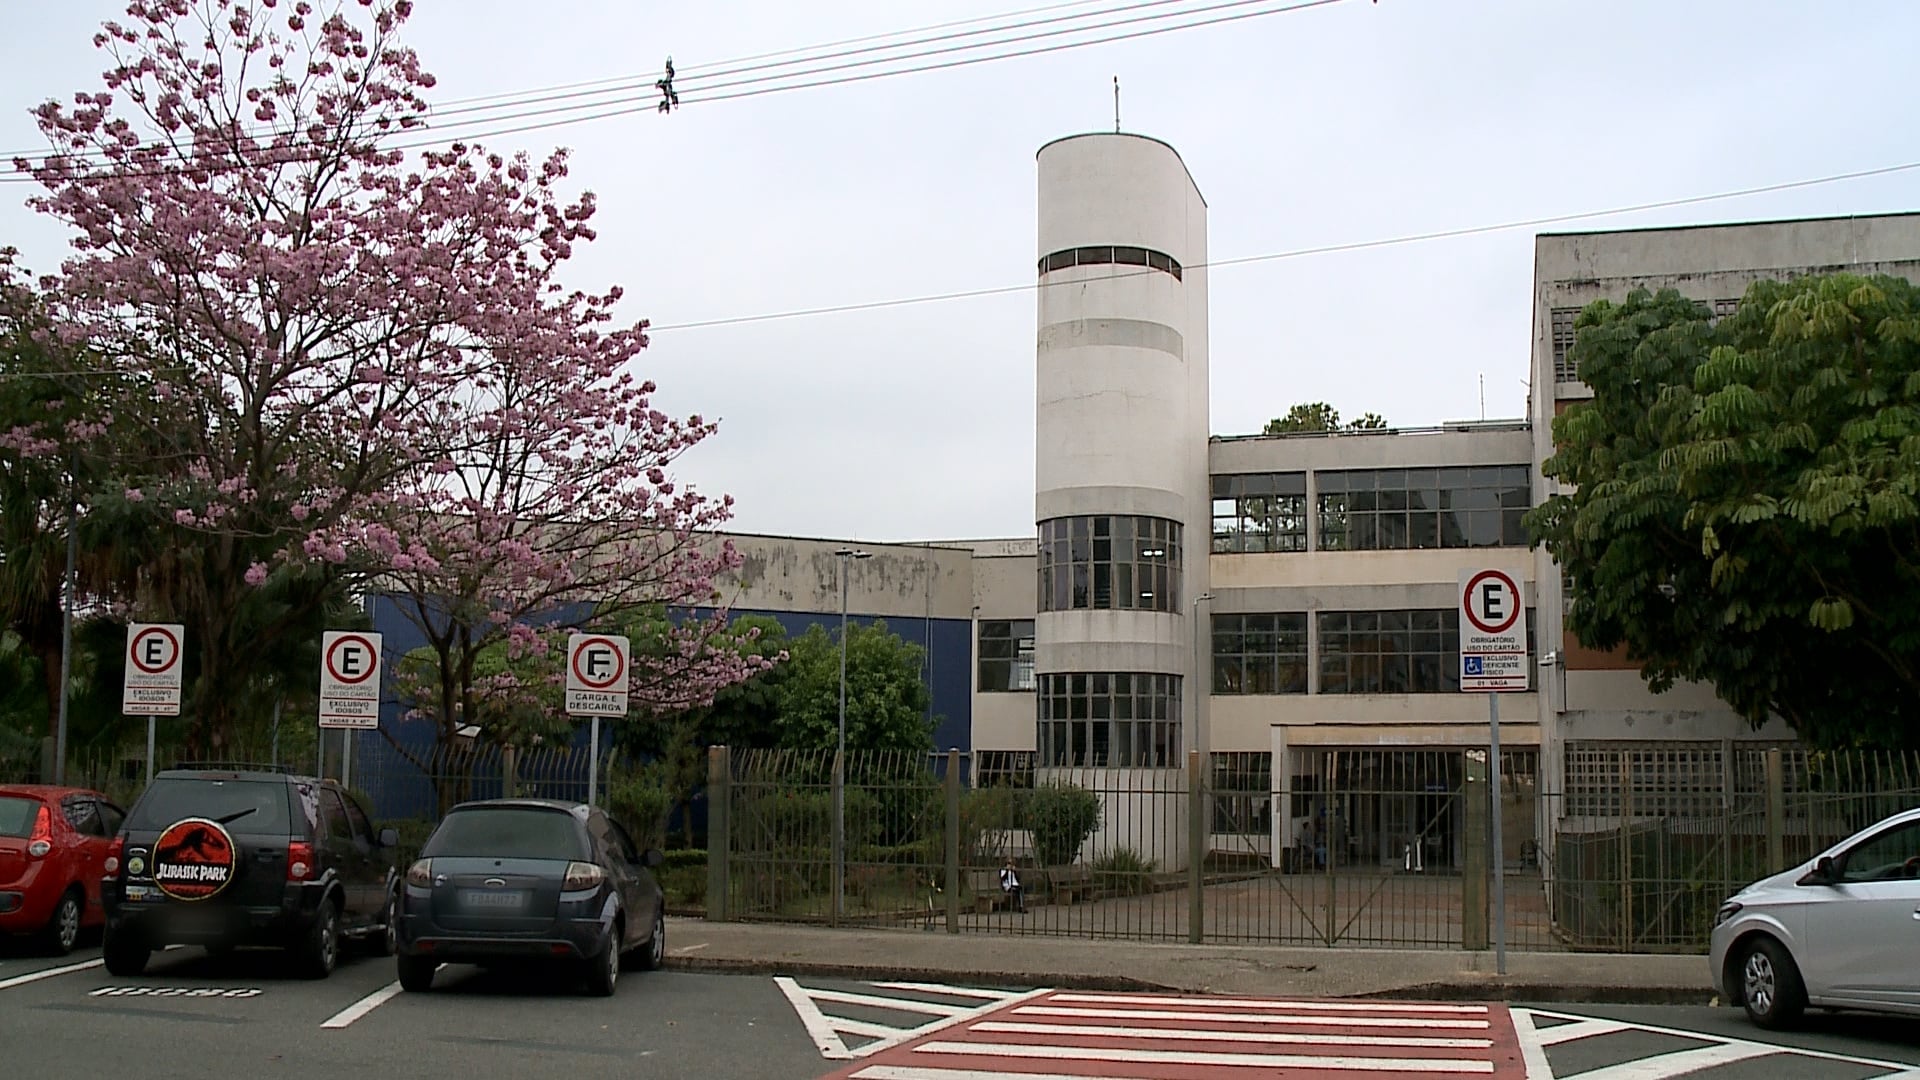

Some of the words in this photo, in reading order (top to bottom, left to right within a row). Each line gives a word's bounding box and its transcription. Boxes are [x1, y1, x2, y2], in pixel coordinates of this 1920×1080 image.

[1482, 585, 1503, 619] E
[146, 639, 164, 665] E
[342, 647, 361, 674] E
[569, 702, 621, 711] DESCARGA
[575, 693, 608, 702] CARGA
[156, 863, 199, 880] JURASSIC
[200, 864, 227, 881] PARK
